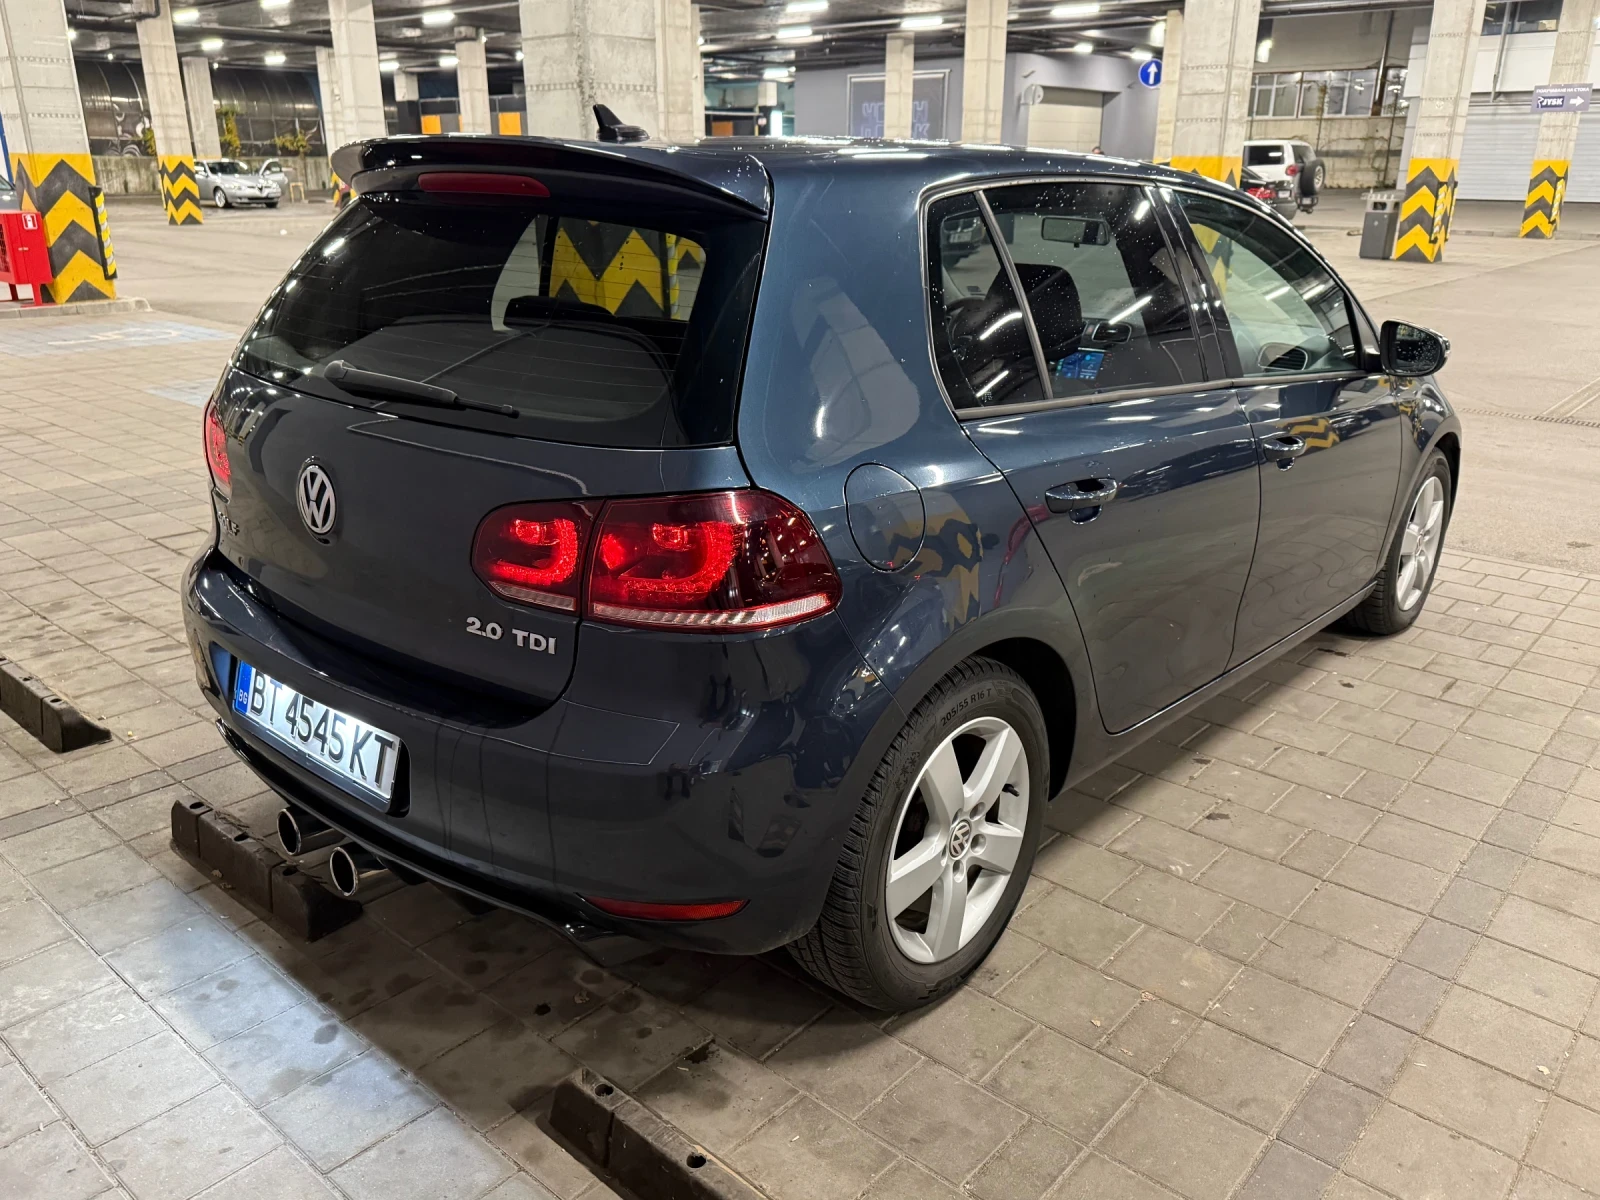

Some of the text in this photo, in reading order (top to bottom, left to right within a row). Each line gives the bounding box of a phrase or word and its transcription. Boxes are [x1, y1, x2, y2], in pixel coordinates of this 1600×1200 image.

[466, 616, 557, 655] 2.0 TDI
[238, 688, 249, 705] BG
[941, 698, 969, 727] 205/55
[970, 690, 985, 704] R16
[250, 669, 395, 788] BT 4545 KT
